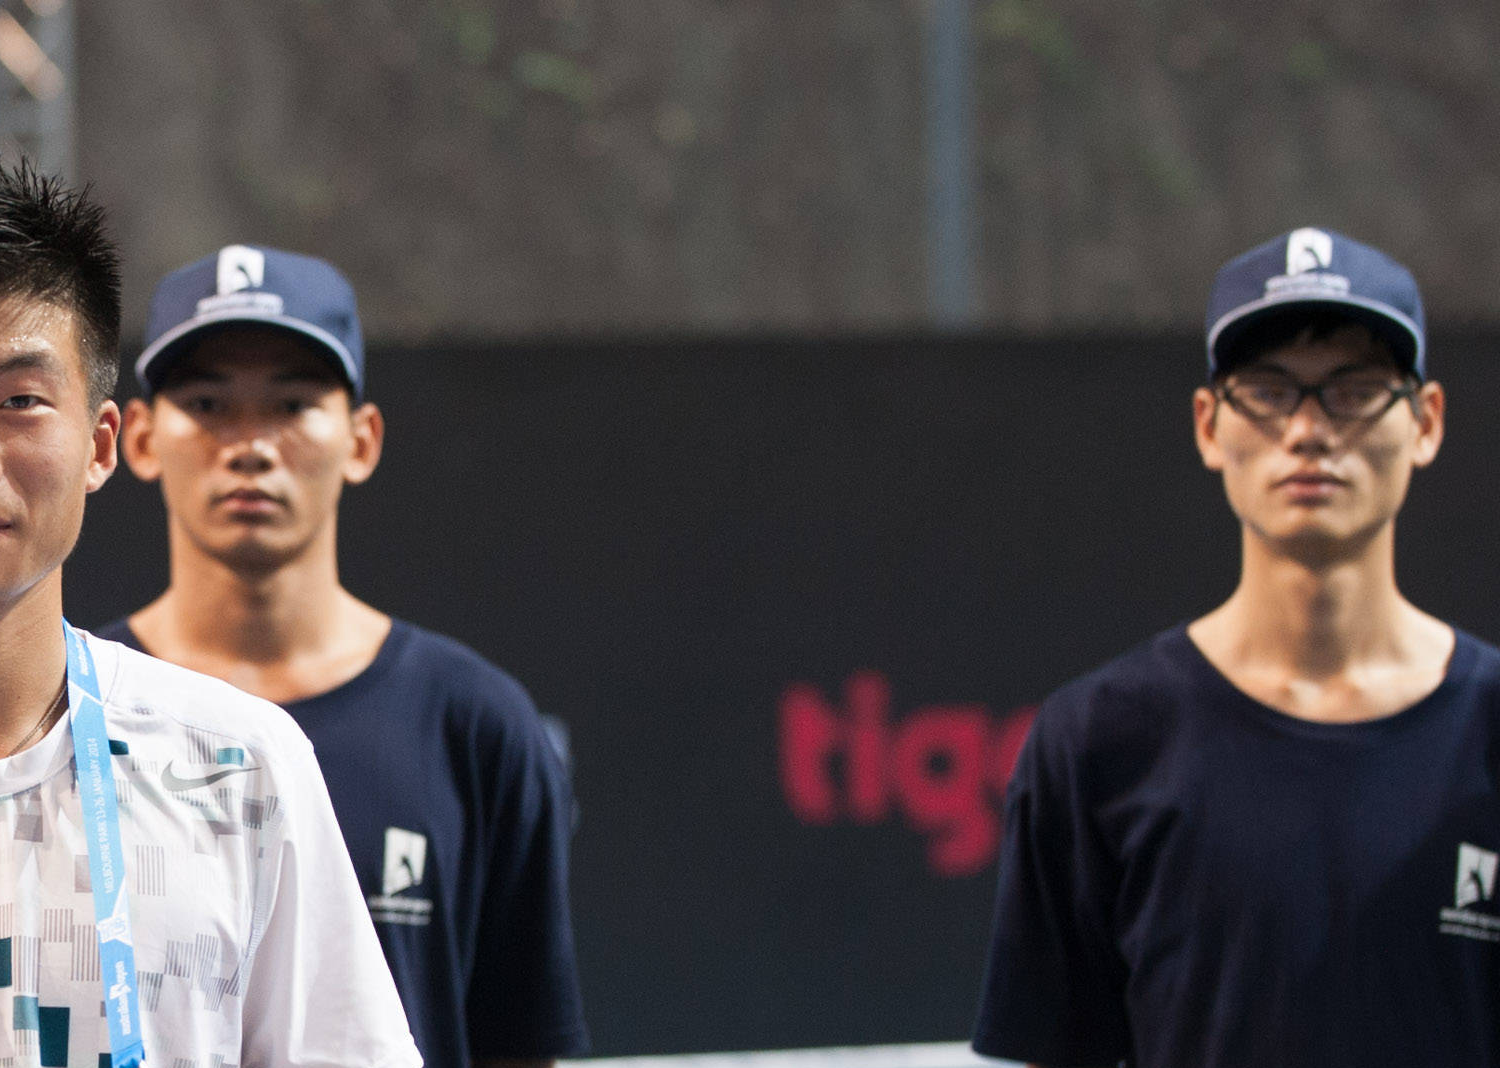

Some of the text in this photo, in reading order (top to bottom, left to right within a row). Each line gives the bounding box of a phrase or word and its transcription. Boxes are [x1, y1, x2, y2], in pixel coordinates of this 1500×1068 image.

[90, 759, 104, 795] JANUARY
[778, 669, 1042, 876] tig
[97, 820, 109, 842] PARK
[97, 844, 115, 893] MELBOURNE
